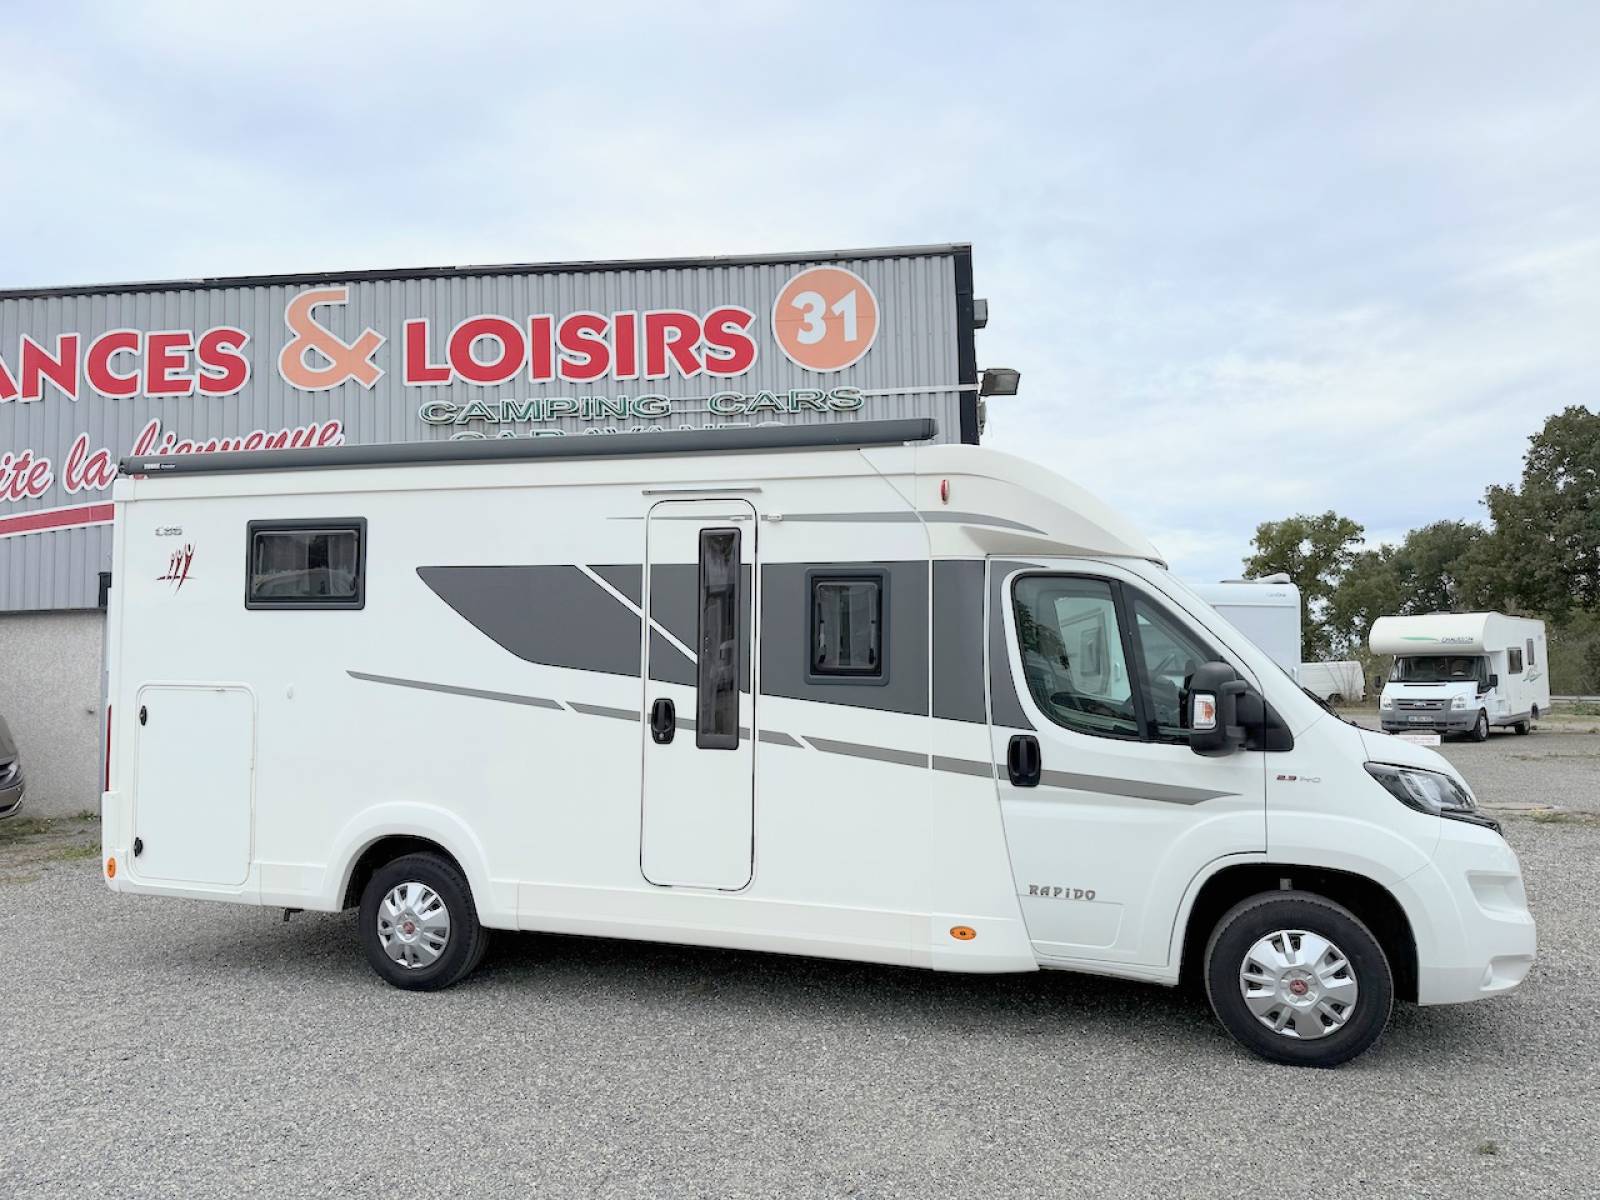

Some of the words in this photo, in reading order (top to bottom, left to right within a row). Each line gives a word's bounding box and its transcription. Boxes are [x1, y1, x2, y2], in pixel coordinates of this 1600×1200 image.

[278, 286, 387, 391] &
[403, 305, 757, 387] LOISIRS
[789, 289, 860, 346] 31
[418, 394, 672, 425] CAMPING
[707, 386, 865, 416] CARS
[63, 432, 118, 494] la
